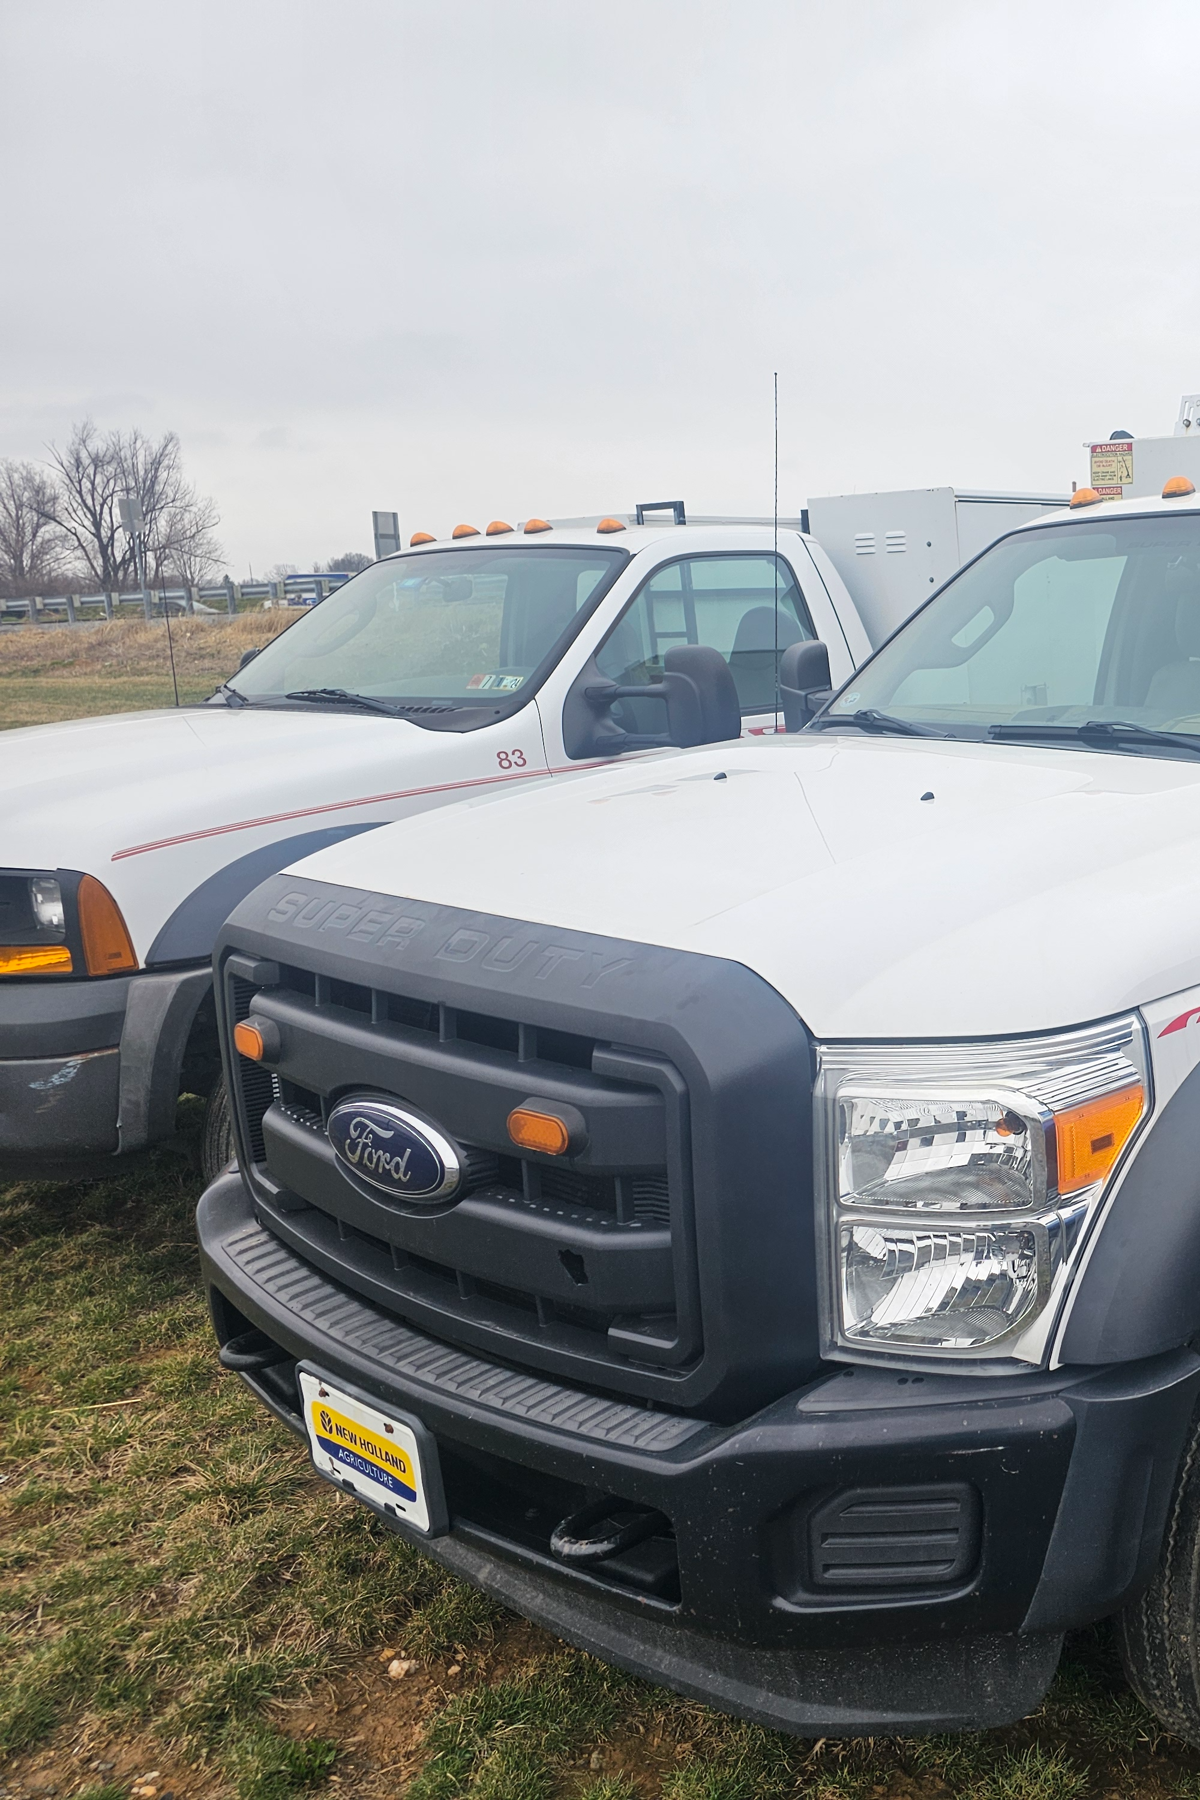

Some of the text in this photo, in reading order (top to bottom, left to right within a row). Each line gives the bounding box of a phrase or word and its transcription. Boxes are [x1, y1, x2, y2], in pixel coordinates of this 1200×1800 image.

[1101, 444, 1128, 452] DANGER
[1099, 487, 1122, 495] DANGER
[496, 748, 527, 770] 83
[267, 891, 636, 990] SUPER DUTY
[344, 1116, 412, 1183] Ford
[335, 1422, 406, 1474] NEW HOLLAND
[338, 1449, 394, 1489] AGRICULTURE
